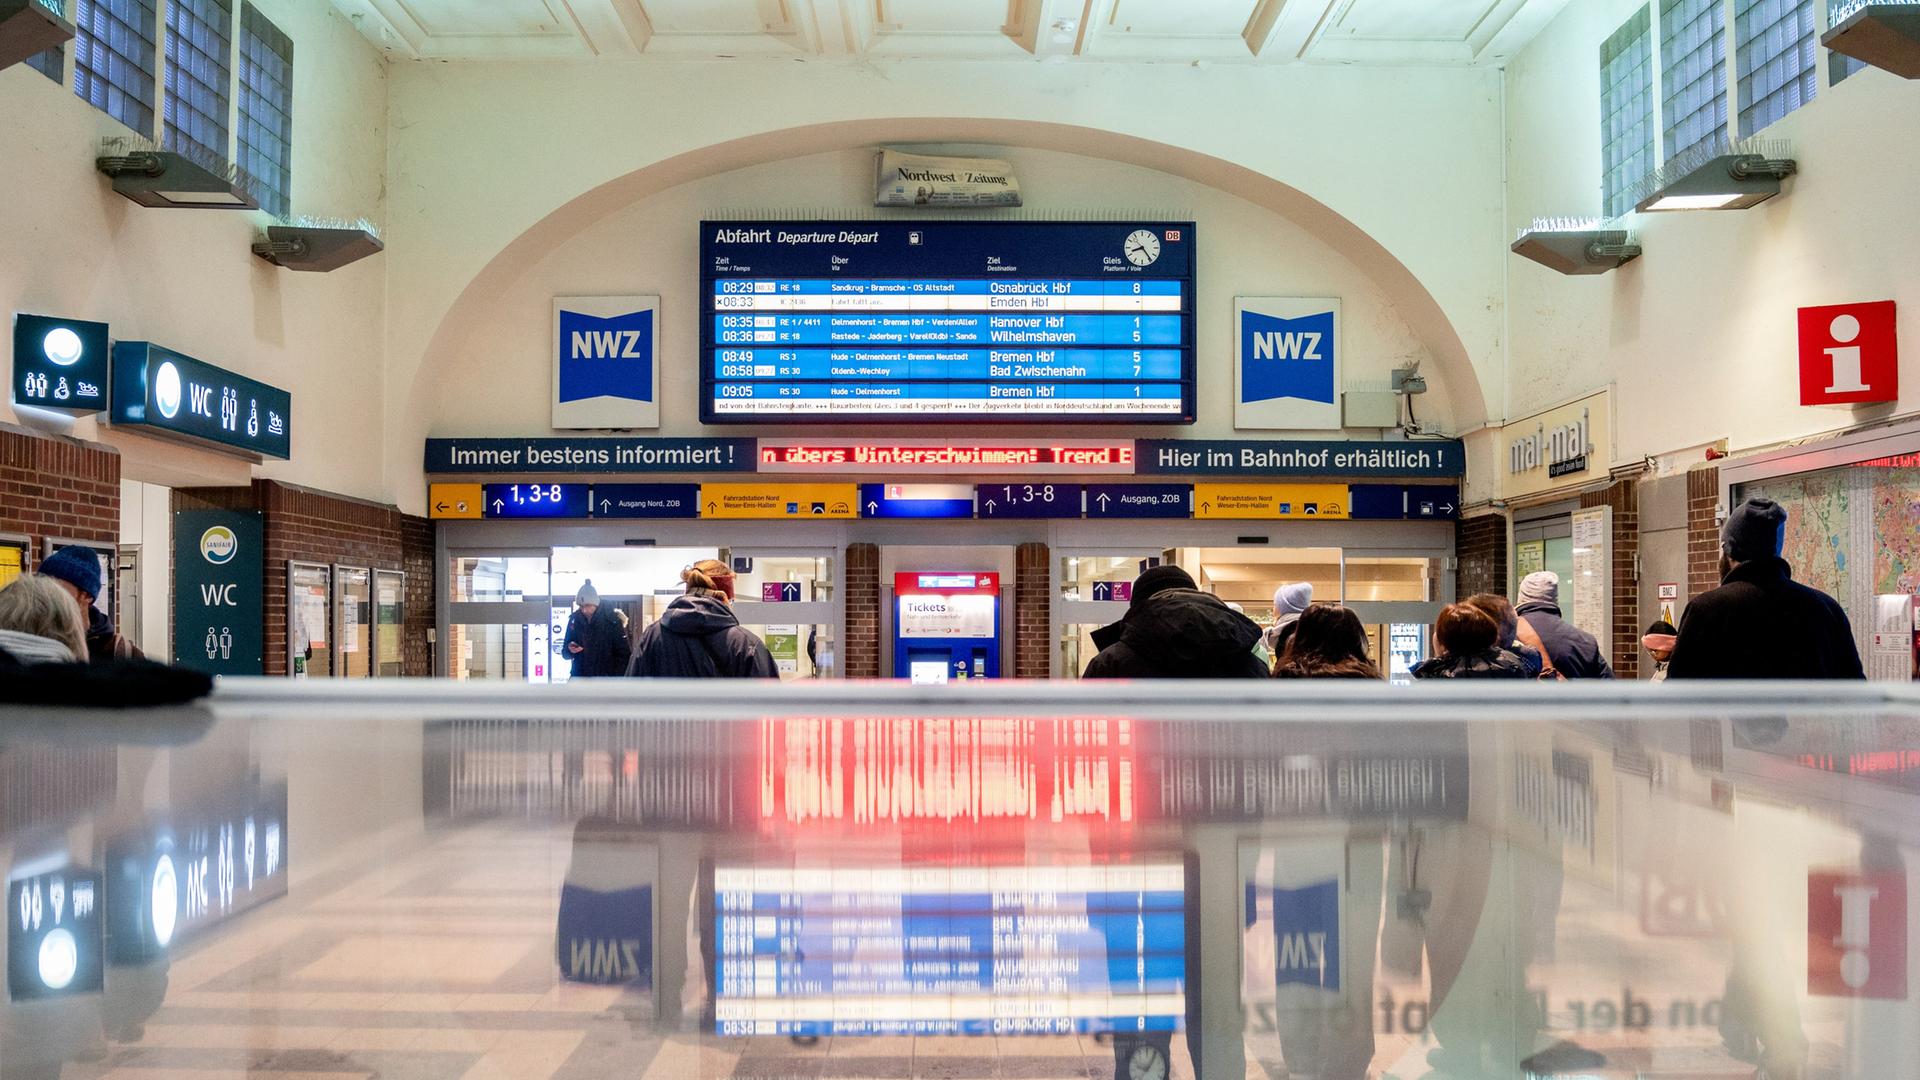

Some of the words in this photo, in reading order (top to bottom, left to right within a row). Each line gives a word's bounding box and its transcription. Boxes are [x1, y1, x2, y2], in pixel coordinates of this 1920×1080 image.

[898, 167, 956, 183] Nordwest
[965, 172, 1008, 186] Zeitung
[715, 229, 771, 243] Abfahrt
[777, 231, 836, 245] Departure
[838, 230, 879, 245] Départ
[1167, 231, 1180, 240] DB
[715, 256, 729, 265] Zeit
[831, 256, 849, 264] Über
[732, 265, 751, 273] Temps
[723, 282, 753, 293] 08:29
[831, 284, 864, 293] Sandkrug
[990, 282, 1048, 293] Osnabrück
[1052, 282, 1071, 293] Hbf
[1132, 283, 1141, 293] 8
[723, 296, 753, 307] 08:33
[990, 297, 1027, 307] Emden
[1031, 297, 1048, 307] Hbf
[722, 316, 753, 327] 08:35
[831, 318, 876, 326] Delmenhorst
[990, 316, 1041, 328] Hannover
[1045, 316, 1064, 327] Hbf
[1133, 316, 1140, 327] 1
[722, 331, 753, 341] 08:36
[868, 333, 902, 341] Jaderberg
[991, 331, 1076, 342] Wilhelmshaven
[1133, 331, 1140, 342] 5
[571, 330, 640, 359] NWZ
[1253, 331, 1322, 360] NWZ
[722, 351, 753, 362] 08:49
[855, 353, 901, 361] Delmenhorst
[908, 353, 934, 361] Bremen
[936, 353, 968, 361] Neustadt
[990, 352, 1032, 362] Bremen
[1036, 352, 1055, 362] Hbf
[1133, 352, 1140, 362] 5
[722, 366, 753, 376] 08:58
[831, 367, 890, 376] Oldenb.-Wechloy
[990, 366, 1011, 376] Bad
[1014, 366, 1086, 377] Zwischenahn
[1133, 366, 1140, 376] 7
[722, 386, 753, 397] 09:05
[990, 386, 1032, 397] Bremen
[1036, 386, 1055, 397] Hbf
[1134, 387, 1140, 397] 1
[190, 382, 213, 418] WC
[451, 446, 520, 464] Immer
[527, 446, 609, 464] bestens
[616, 445, 721, 464] informiert
[786, 447, 845, 463] übers
[855, 447, 1039, 464] Winterschwimmen:
[1051, 448, 1111, 463] Trend
[1159, 449, 1201, 467] Hier
[1207, 449, 1233, 467] im
[1240, 449, 1328, 467] Bahnhof
[1334, 449, 1430, 468] erhältlich
[510, 485, 525, 504] 1,
[529, 485, 562, 502] 3-8
[1003, 486, 1016, 504] 1,
[1023, 486, 1054, 502] 3-8
[1120, 494, 1160, 504] Ausgang,
[1162, 494, 1180, 503] ZOB
[618, 500, 646, 509] Ausgang
[647, 500, 665, 508] Nord,
[667, 500, 680, 508] ZOB
[200, 583, 237, 606] WC
[1662, 586, 1673, 596] BMZ
[907, 602, 946, 612] Tickets
